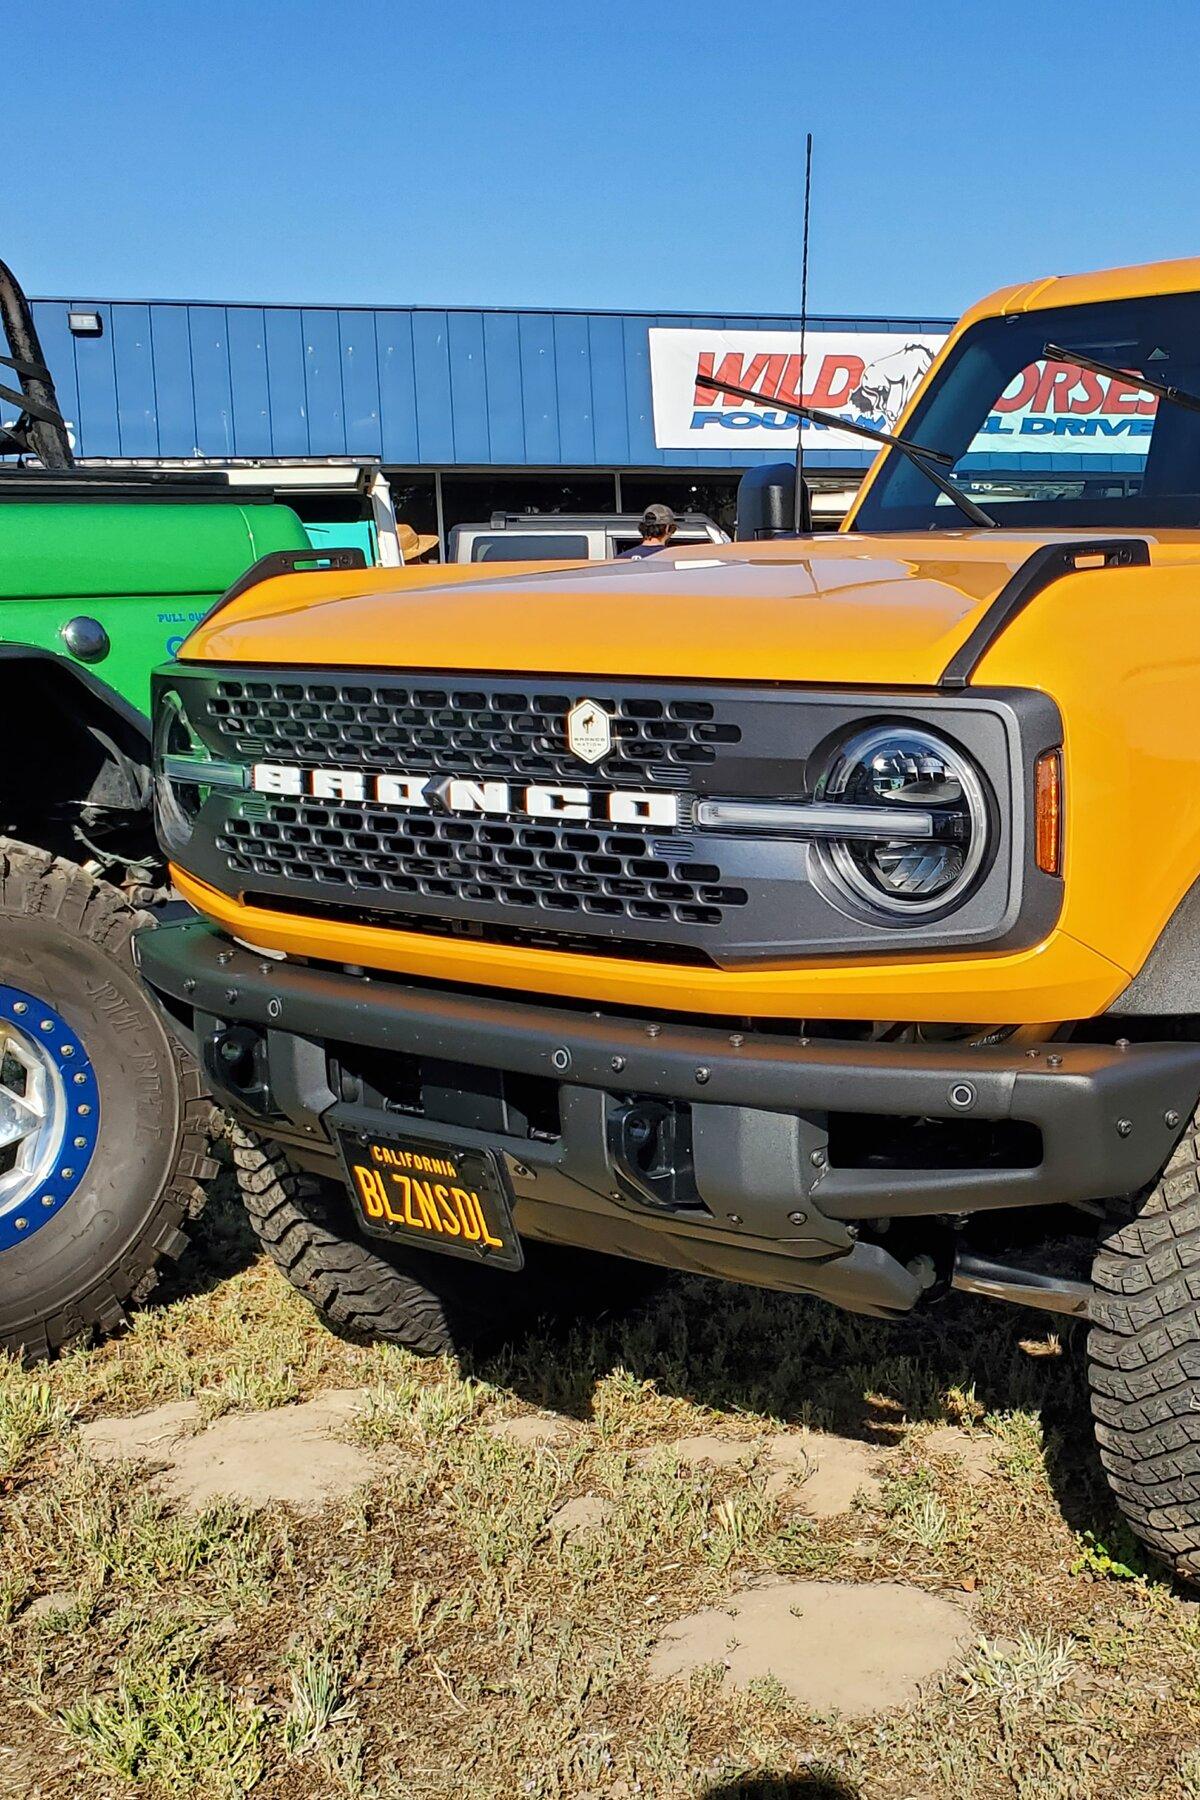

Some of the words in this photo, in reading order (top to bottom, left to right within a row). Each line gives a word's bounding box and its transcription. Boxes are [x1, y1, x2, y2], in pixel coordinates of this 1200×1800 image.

[693, 352, 865, 408] WILD
[1018, 417, 1155, 436] DRIVE
[157, 613, 185, 623] PULL
[188, 612, 206, 622] OU
[254, 763, 677, 827] BRONCO
[373, 1145, 458, 1178] CALIFORNIA
[354, 1165, 503, 1248] BLZNSDL
